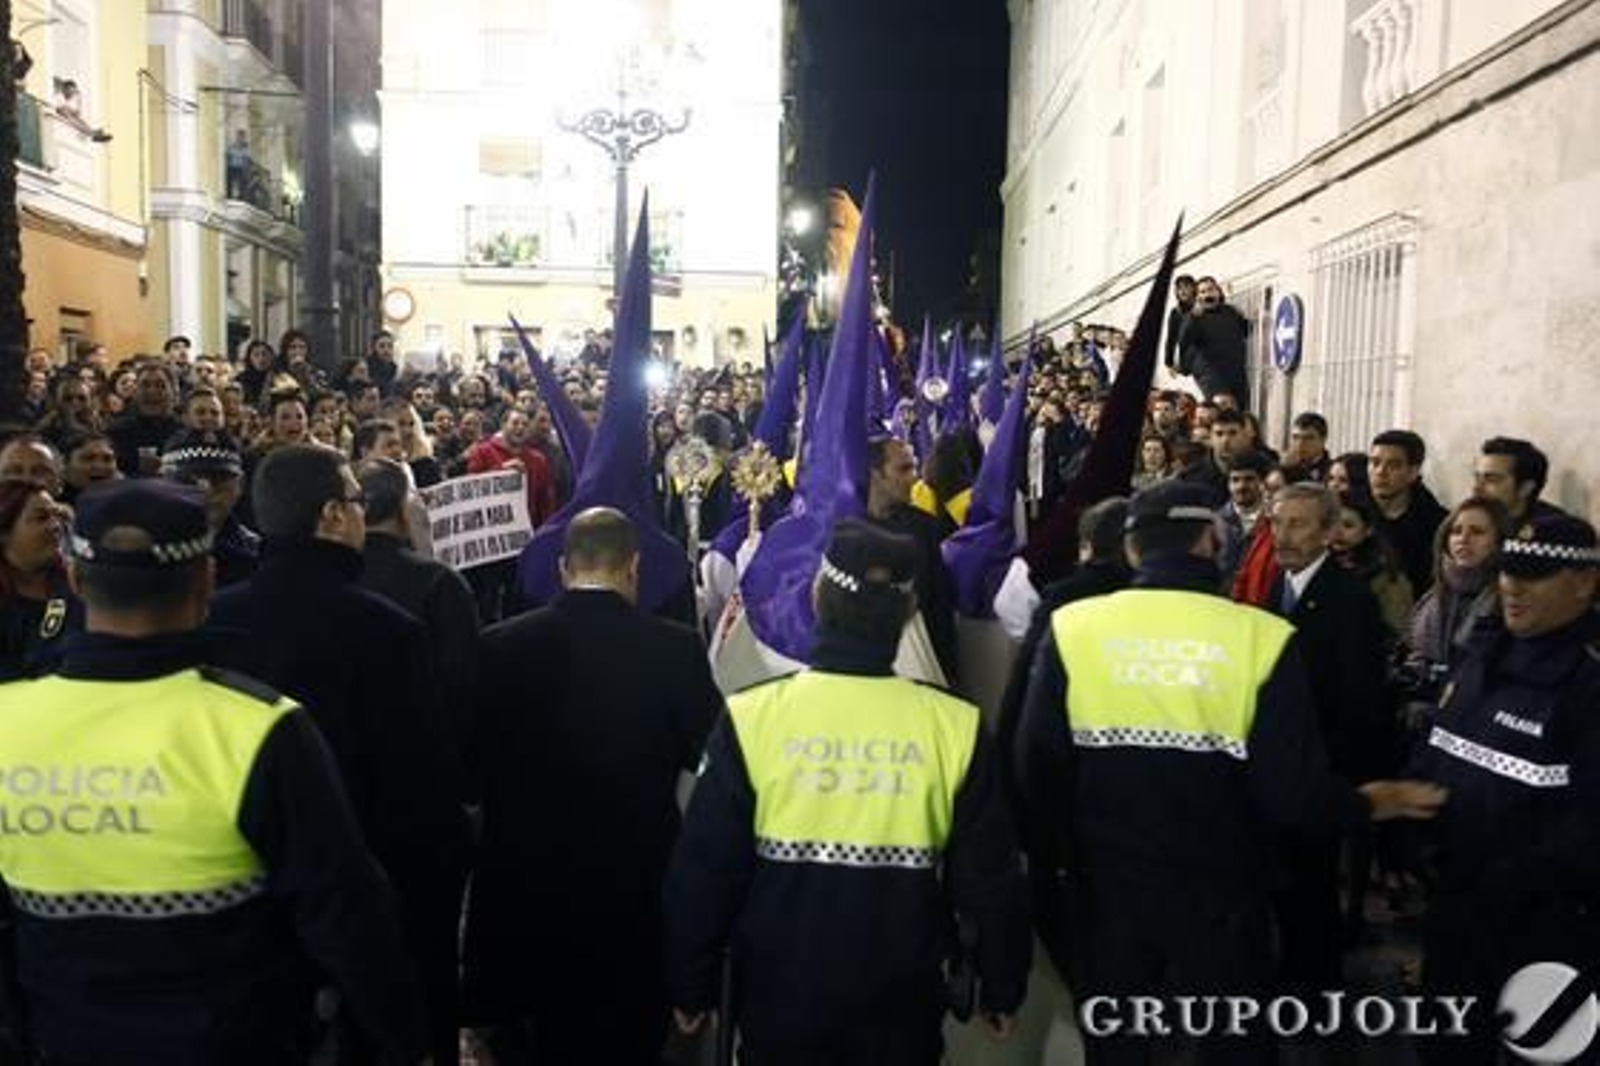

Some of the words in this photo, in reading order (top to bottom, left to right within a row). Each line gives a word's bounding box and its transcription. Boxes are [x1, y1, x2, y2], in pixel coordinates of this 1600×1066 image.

[1102, 638, 1232, 664] POLICIA
[785, 735, 924, 767] POLICIA
[0, 803, 154, 837] LOCAL
